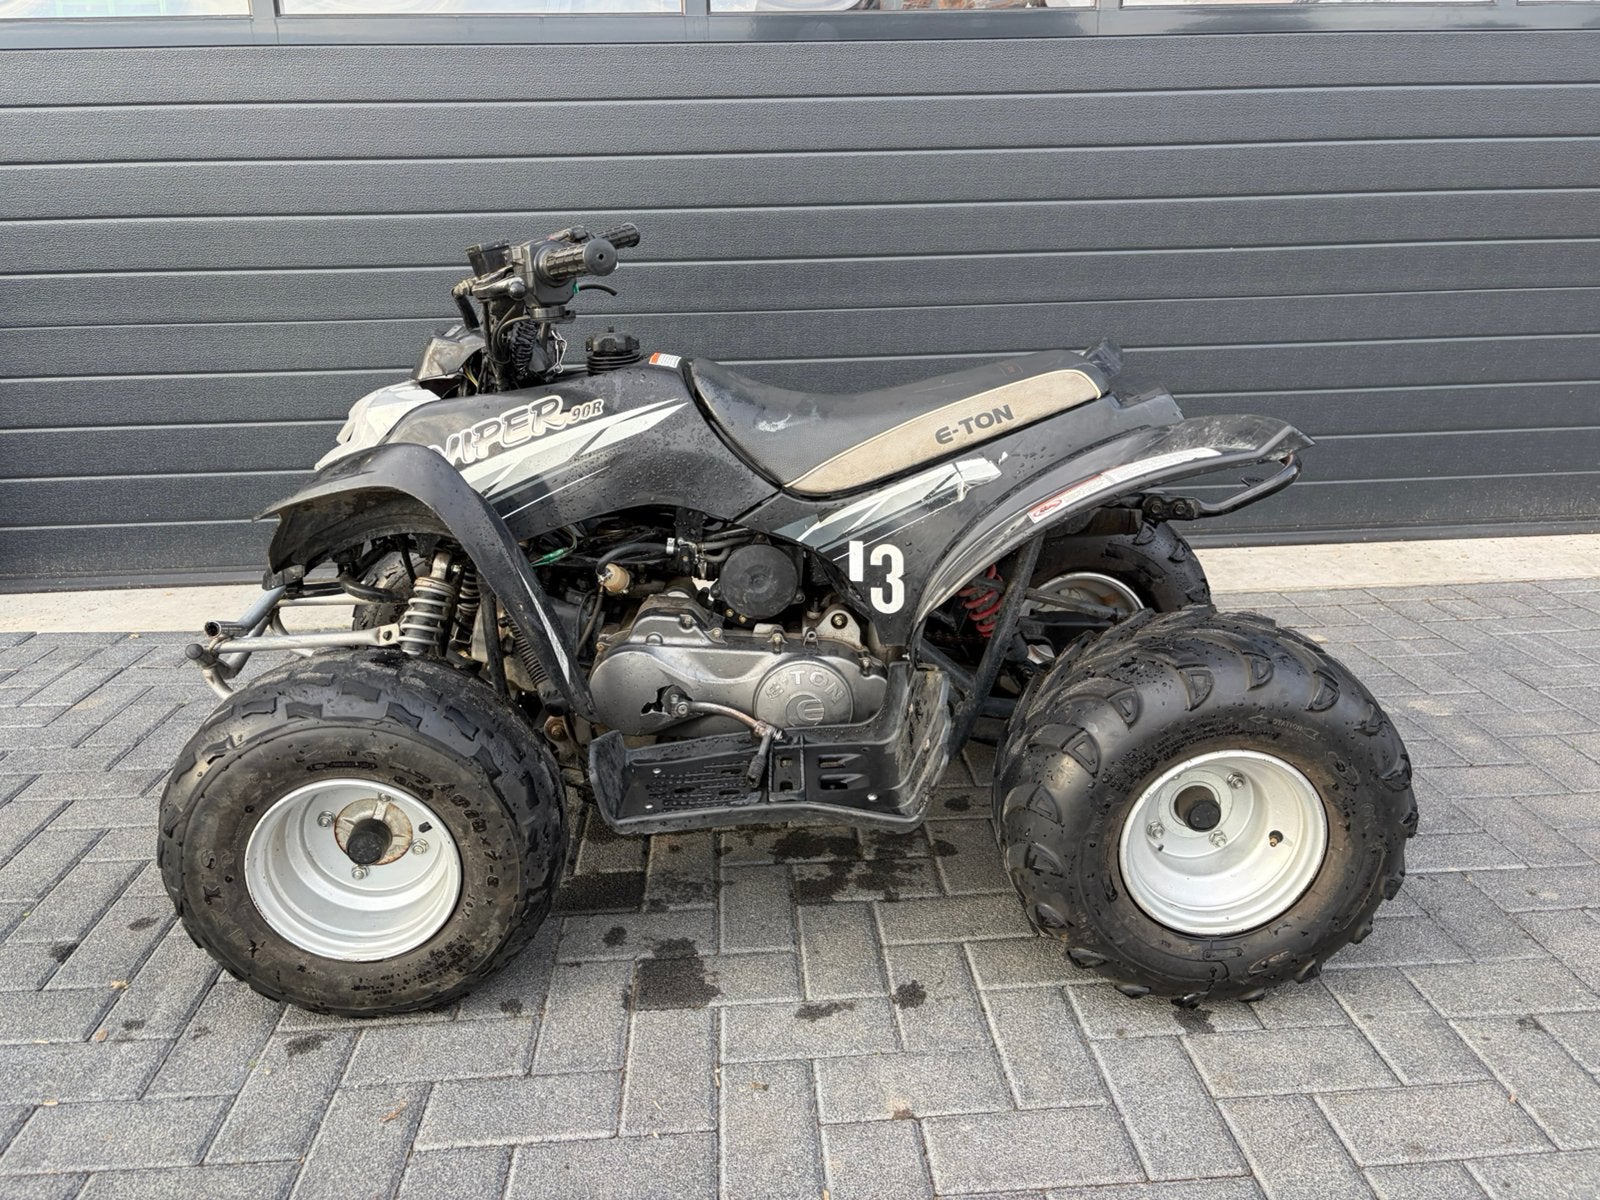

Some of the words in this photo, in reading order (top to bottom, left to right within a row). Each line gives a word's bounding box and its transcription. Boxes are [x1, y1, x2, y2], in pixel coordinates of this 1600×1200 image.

[566, 399, 604, 425] 90R
[935, 404, 1014, 445] E-TON
[765, 670, 844, 705] E-TON
